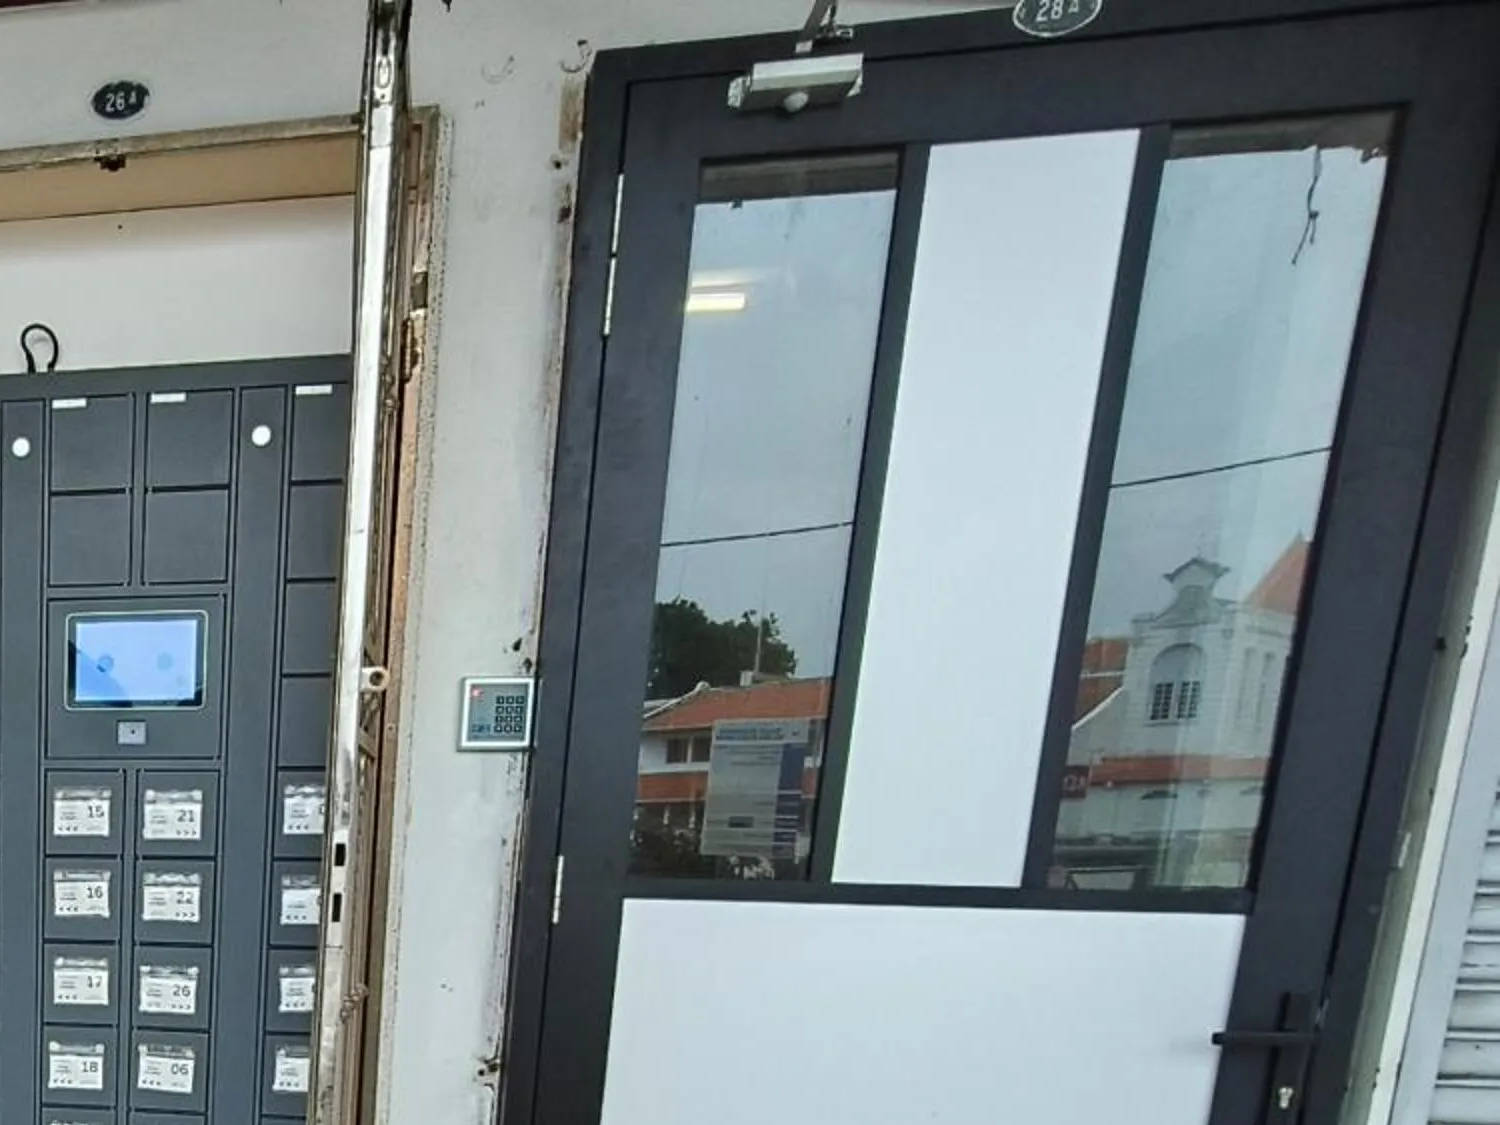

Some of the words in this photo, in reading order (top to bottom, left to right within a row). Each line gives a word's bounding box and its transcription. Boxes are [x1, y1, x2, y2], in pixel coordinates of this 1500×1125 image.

[87, 805, 105, 818] 15
[177, 809, 195, 822] 21
[86, 885, 103, 899] 16
[172, 984, 191, 997] 26
[171, 1063, 189, 1075] 06
